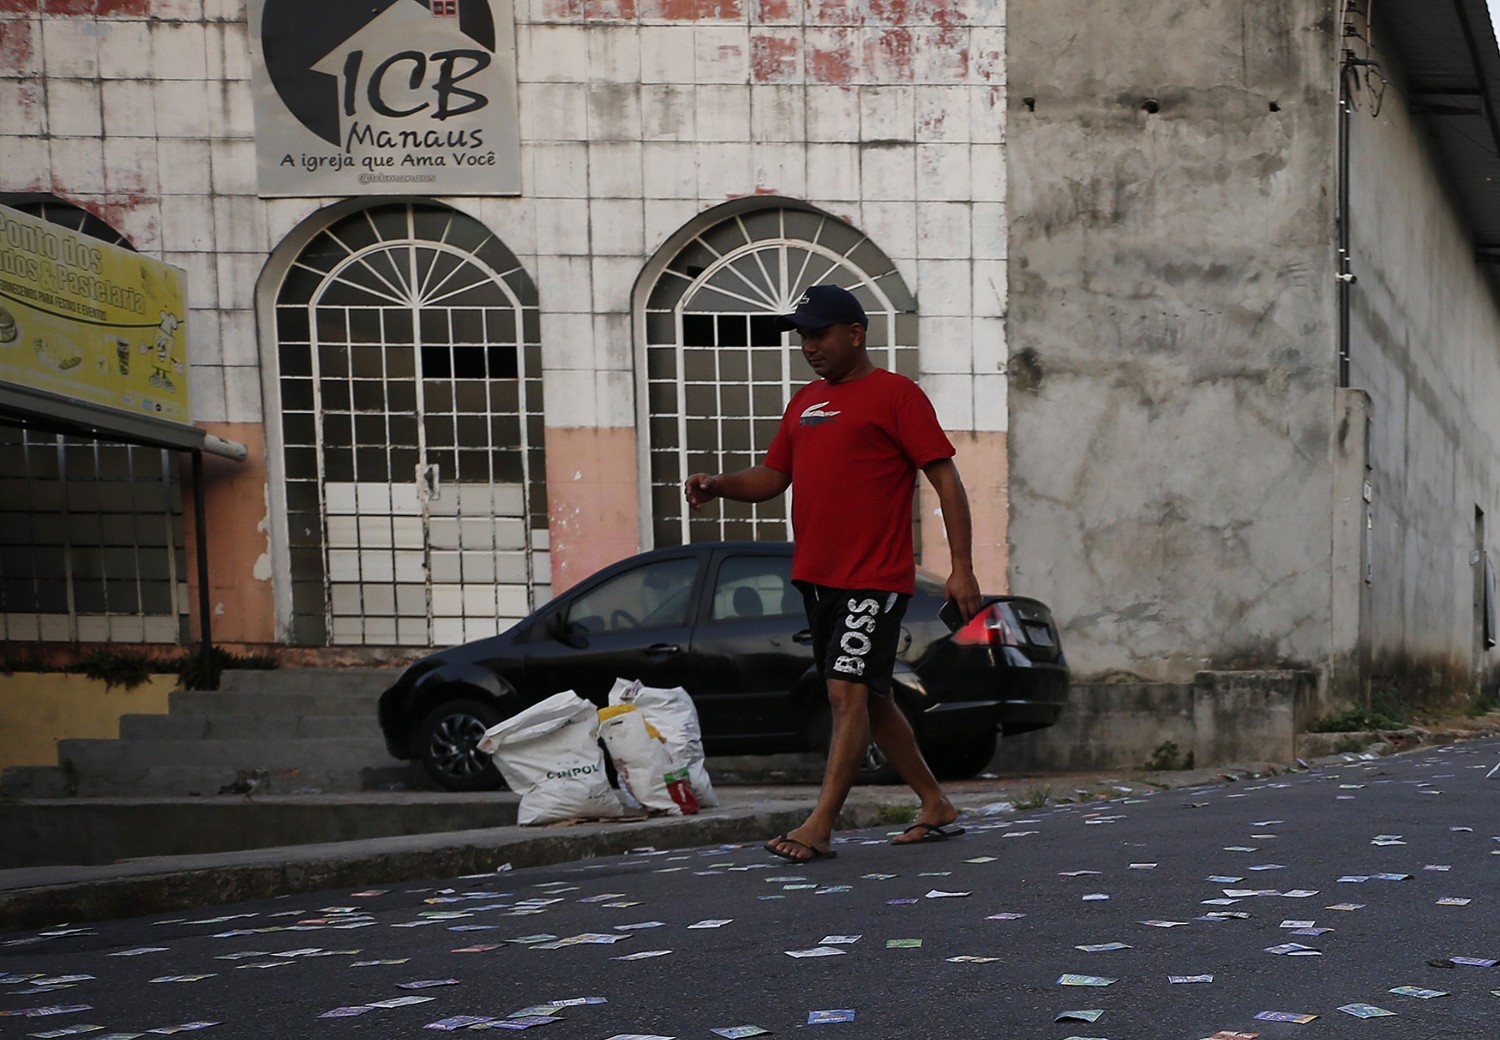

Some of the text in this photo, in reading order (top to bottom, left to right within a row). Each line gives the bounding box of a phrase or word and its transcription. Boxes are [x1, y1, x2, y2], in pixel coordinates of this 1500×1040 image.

[343, 50, 492, 121] ICB
[346, 121, 484, 153] Manaus
[280, 151, 497, 172] A igreja que Ama Você
[62, 236, 104, 276] dos
[59, 264, 147, 315] Pastelaria
[833, 598, 880, 676] BOSS
